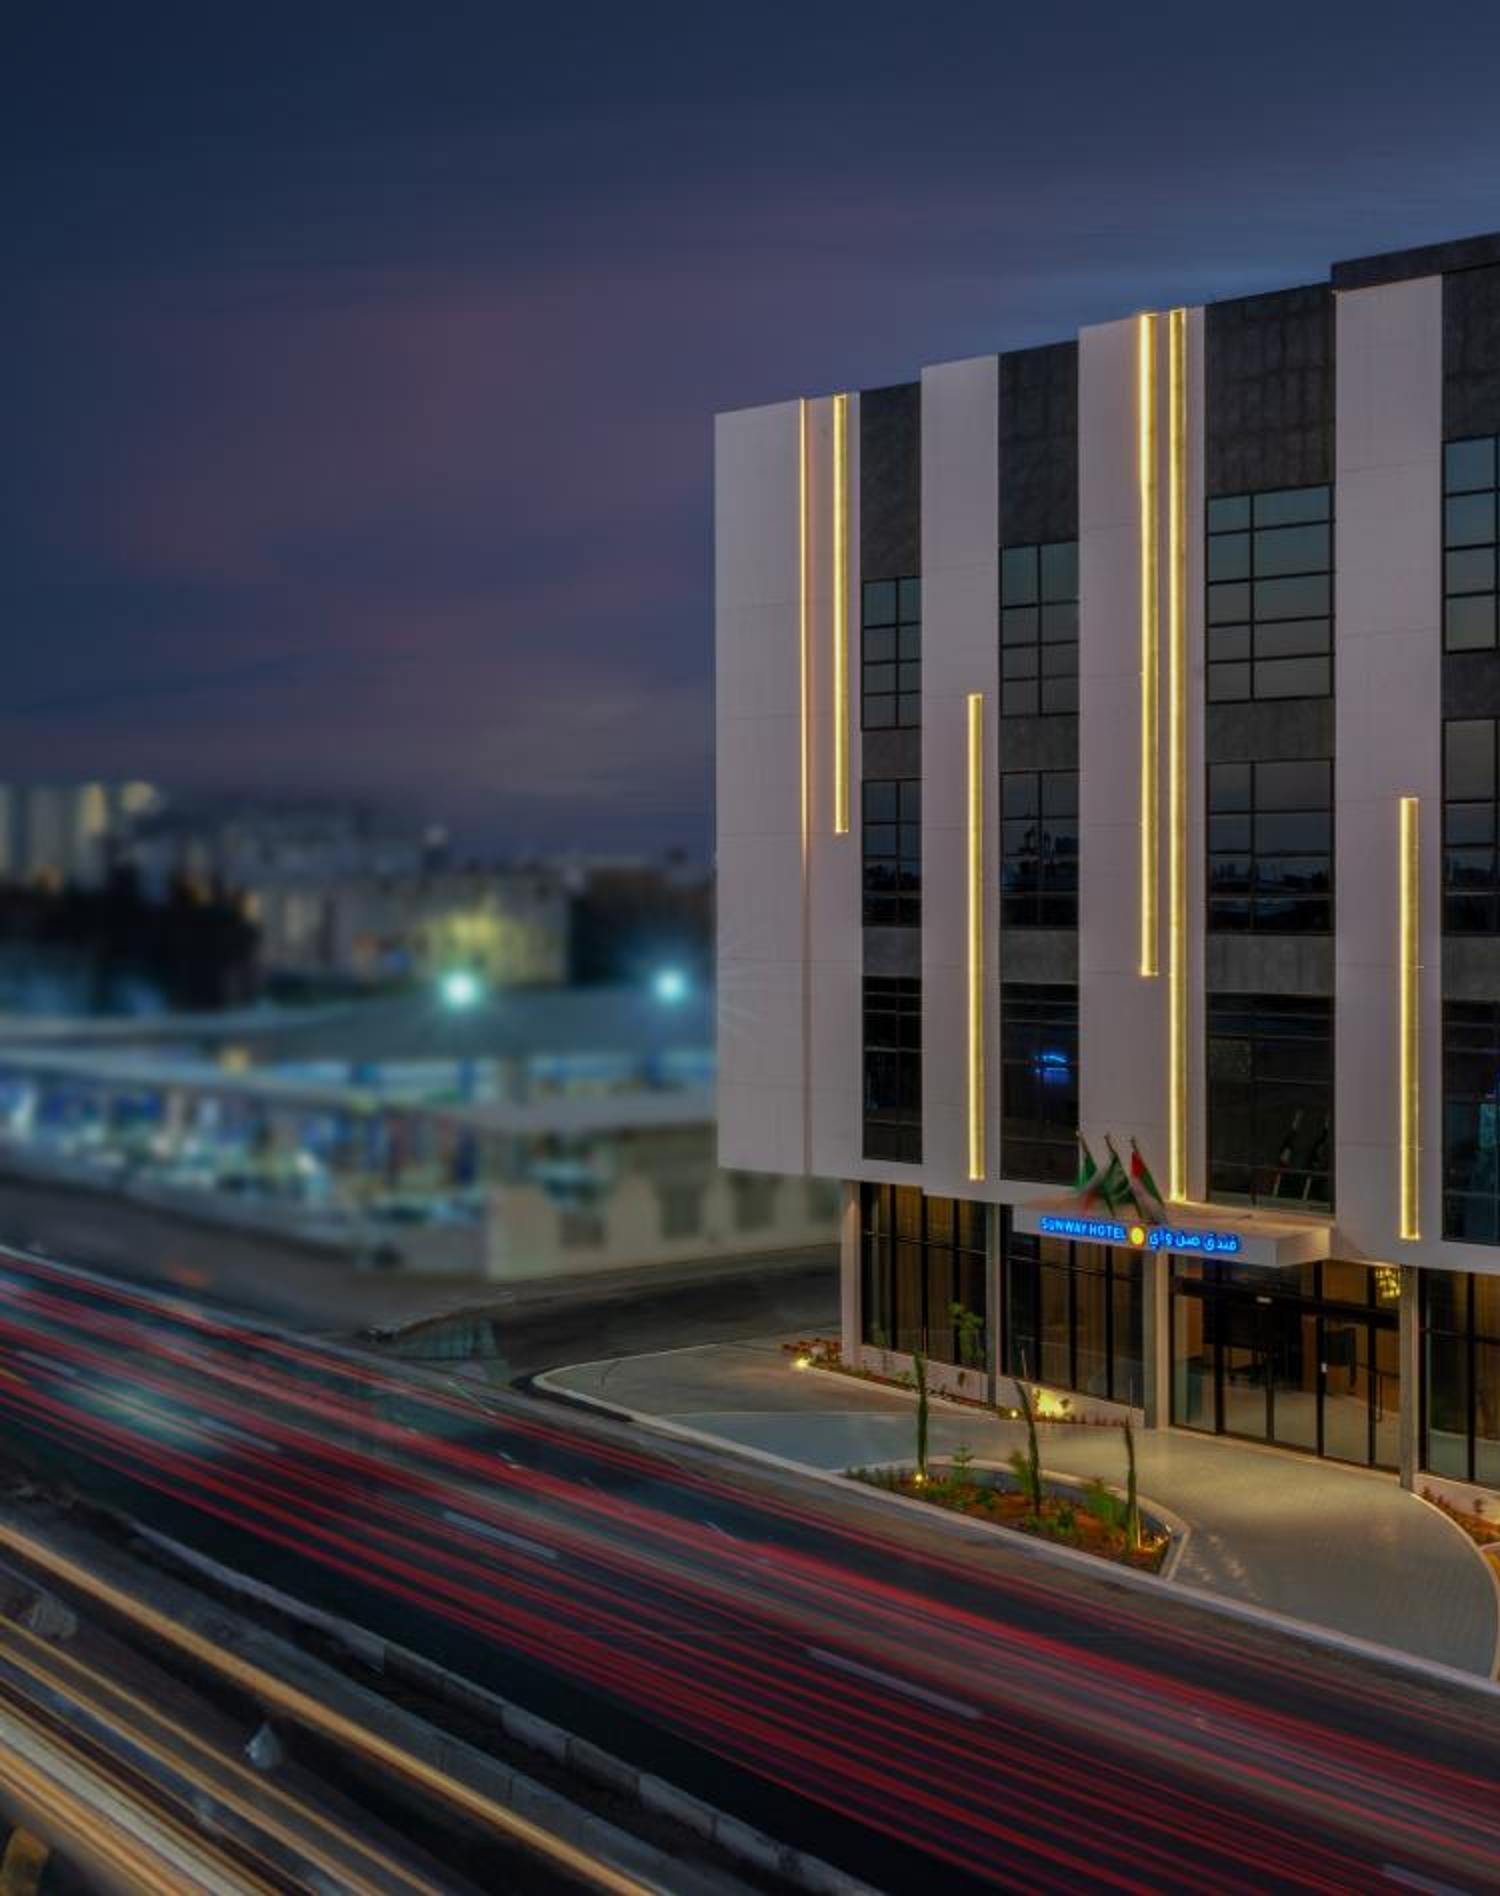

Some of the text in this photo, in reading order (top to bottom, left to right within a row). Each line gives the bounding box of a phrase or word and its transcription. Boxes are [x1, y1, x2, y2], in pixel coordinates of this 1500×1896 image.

[1040, 1217, 1126, 1241] SUNWAY HOTEL
[1175, 1234, 1200, 1247] صن
[1203, 1235, 1238, 1252] فندق
